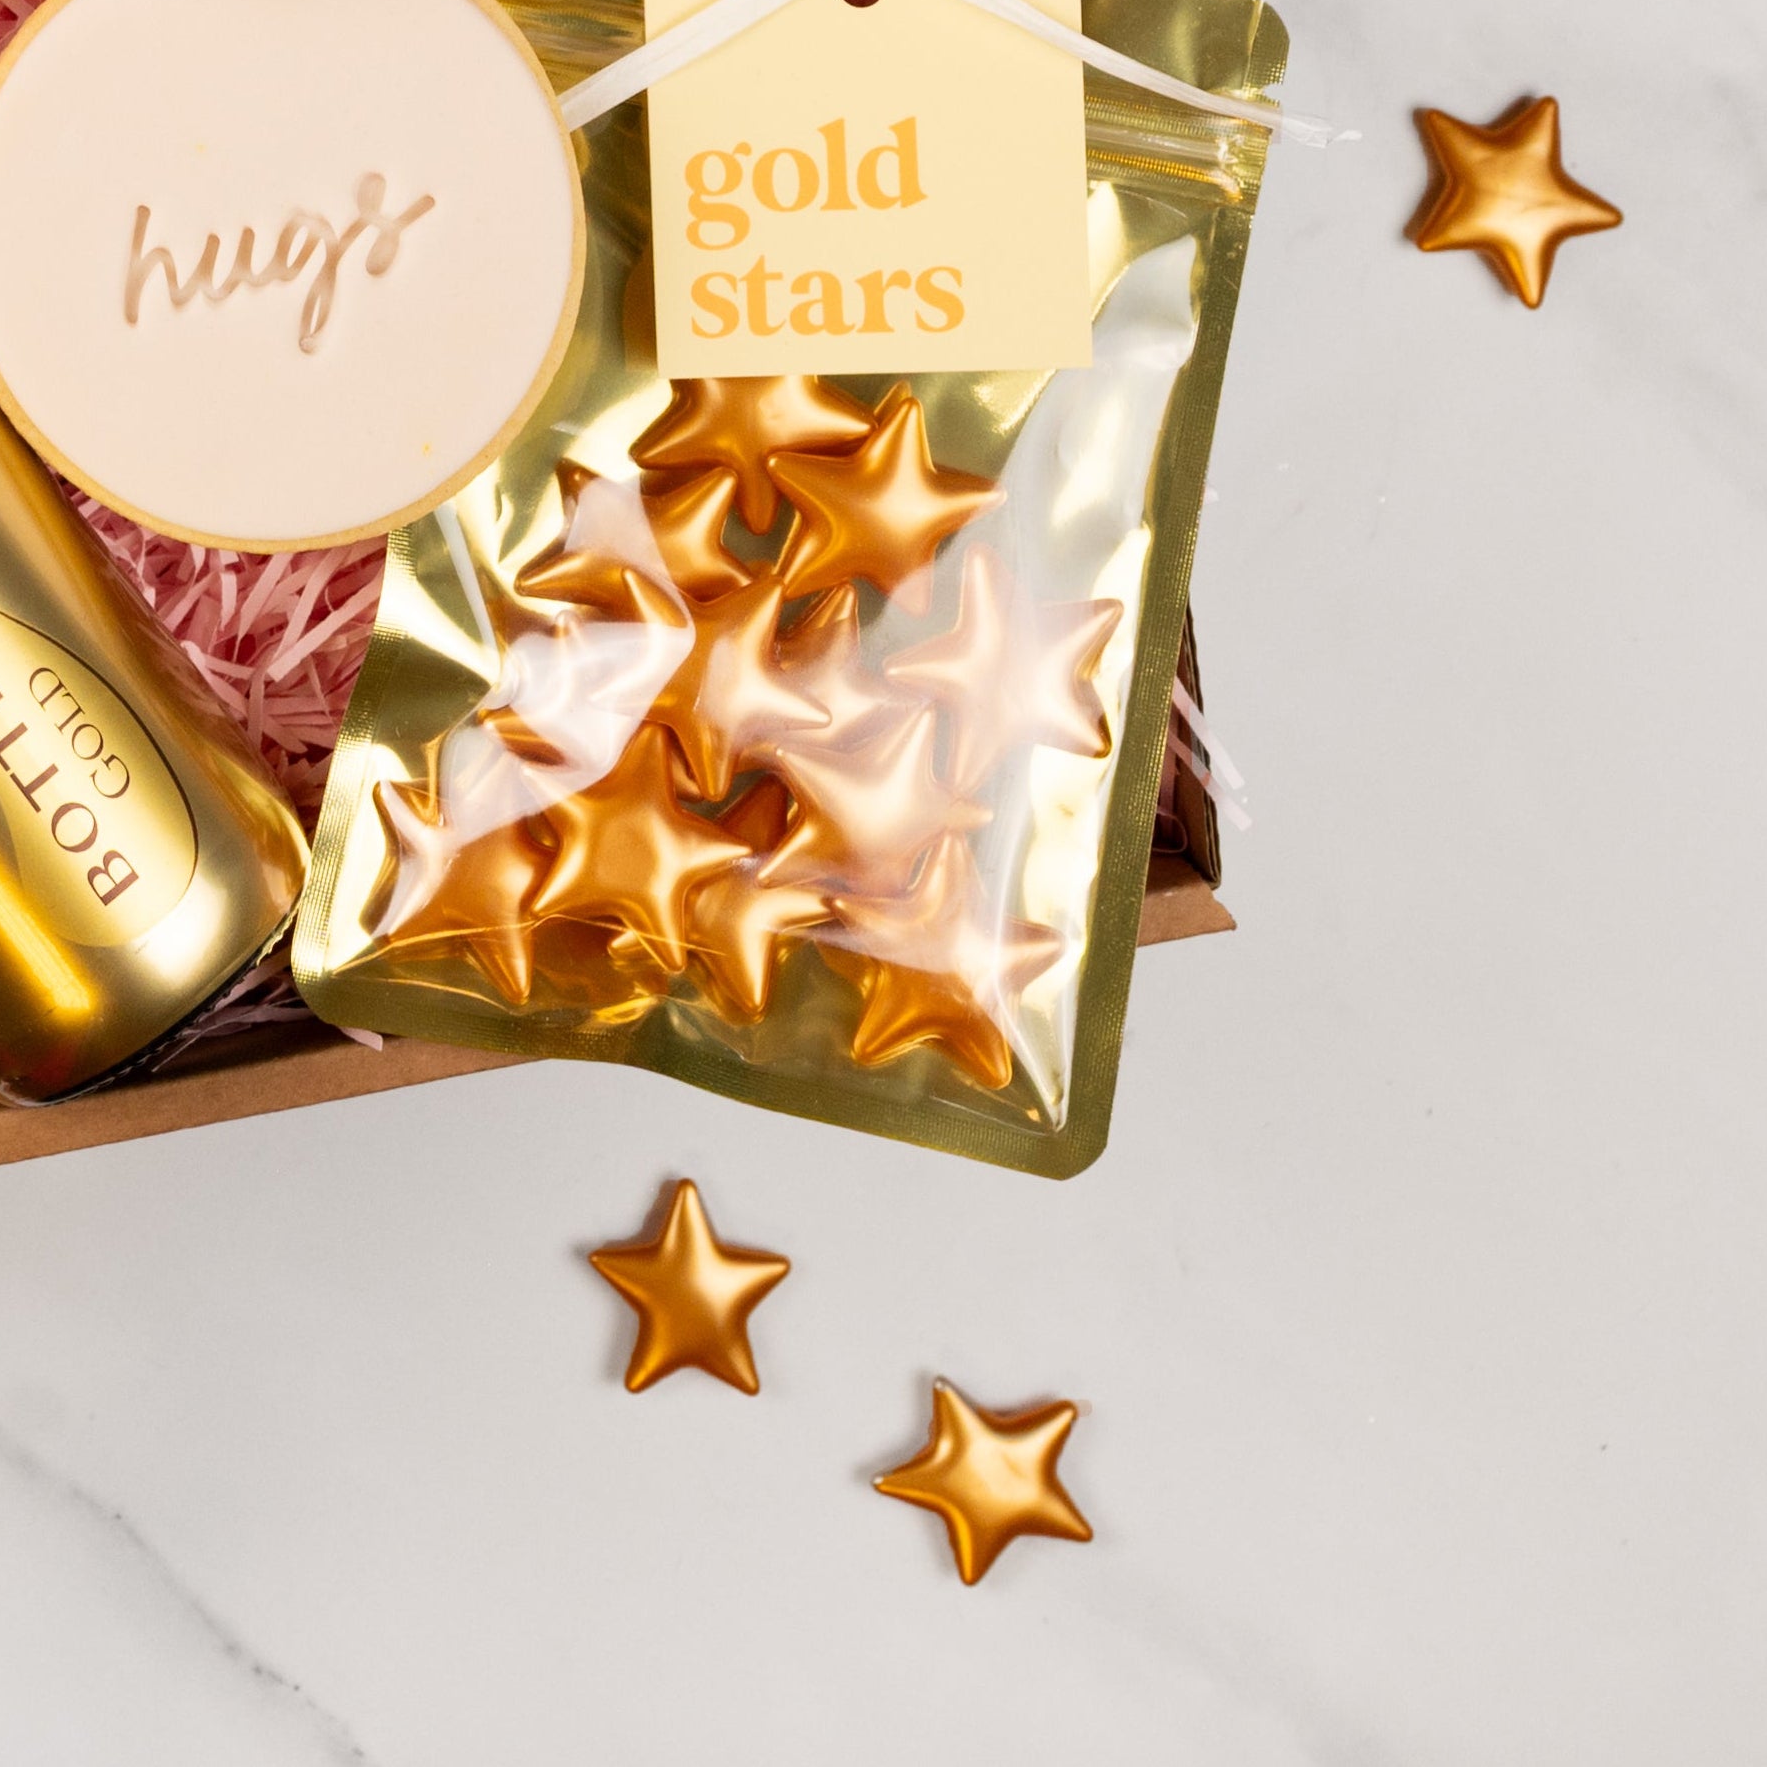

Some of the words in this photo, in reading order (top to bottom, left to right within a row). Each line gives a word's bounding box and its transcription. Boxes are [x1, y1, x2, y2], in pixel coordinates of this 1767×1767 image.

[684, 116, 928, 251] gold
[124, 171, 436, 354] hugs
[690, 254, 965, 339] stars
[29, 667, 130, 799] GOLD
